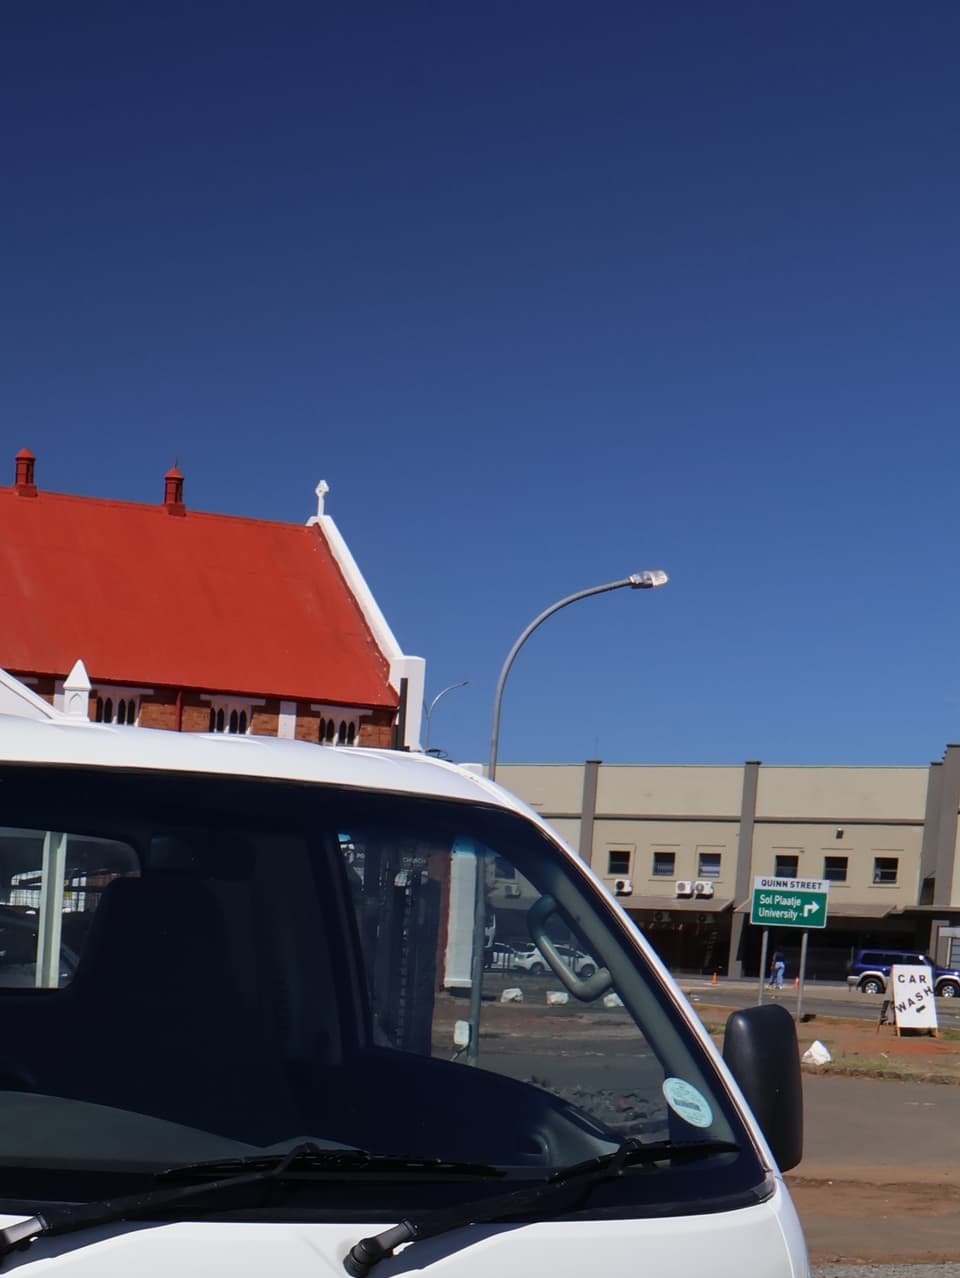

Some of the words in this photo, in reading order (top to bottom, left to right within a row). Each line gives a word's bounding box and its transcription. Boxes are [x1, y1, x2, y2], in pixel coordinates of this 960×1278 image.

[761, 880, 788, 888] QUINN
[790, 881, 822, 889] STREET
[760, 894, 772, 904] Sol
[774, 895, 801, 908] Plaatje
[758, 908, 798, 921] University
[897, 974, 927, 984] CAR
[896, 985, 934, 1013] WASH
